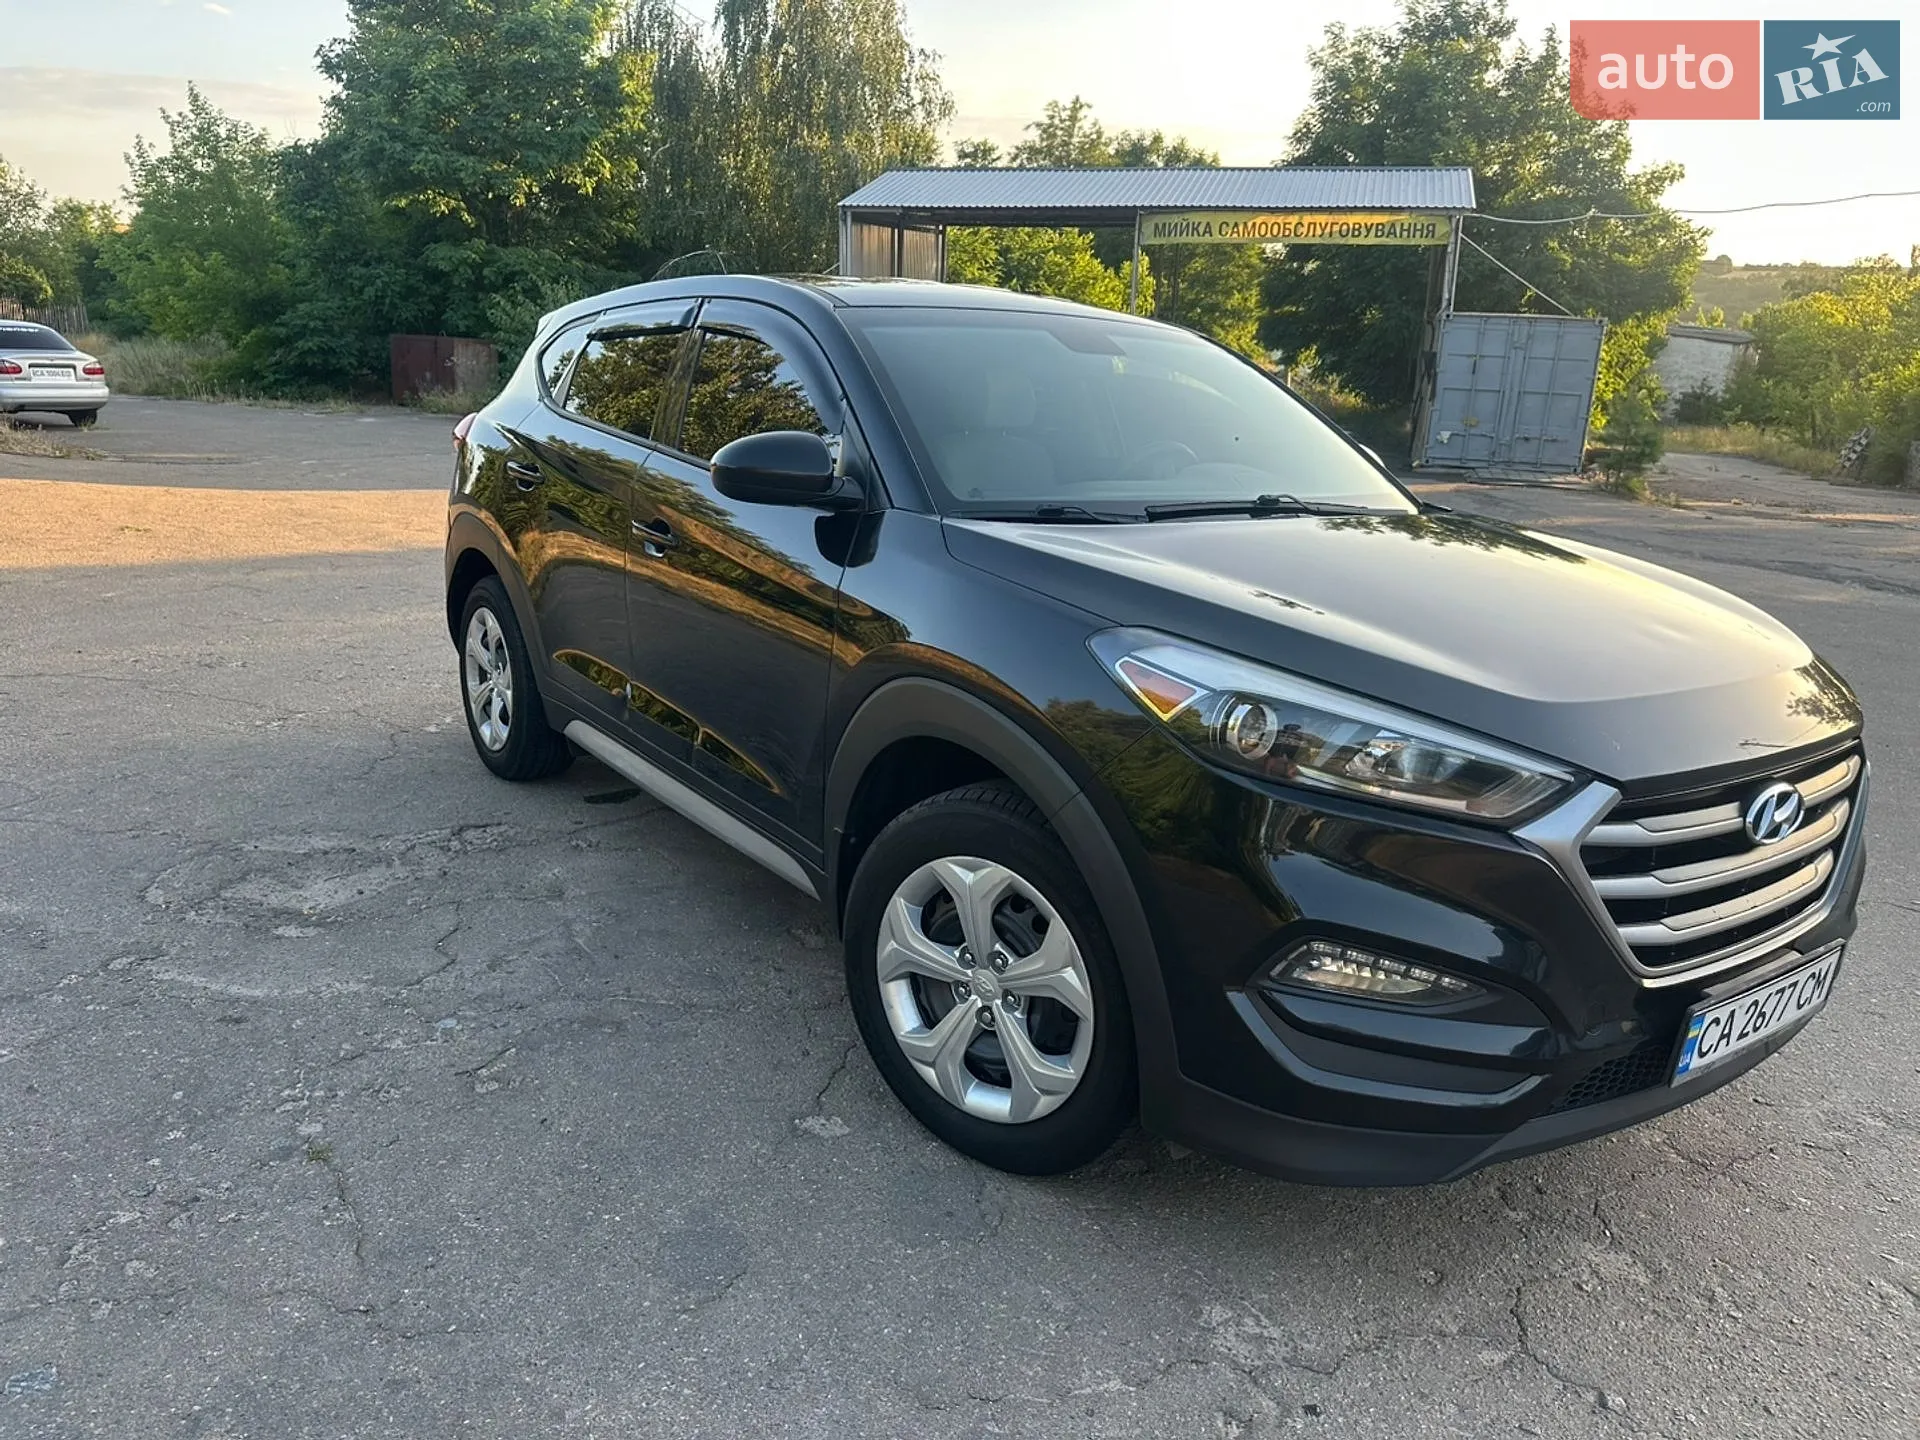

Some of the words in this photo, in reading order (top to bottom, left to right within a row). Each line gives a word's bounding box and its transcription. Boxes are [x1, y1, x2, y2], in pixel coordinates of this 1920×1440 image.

[1153, 219, 1214, 239] МИЙКА
[1218, 219, 1437, 240] САМООБСЛУГОВУВАННЯ
[1697, 1008, 1736, 1059] CA
[1736, 979, 1800, 1041] 2677
[1796, 962, 1833, 1011] CM
